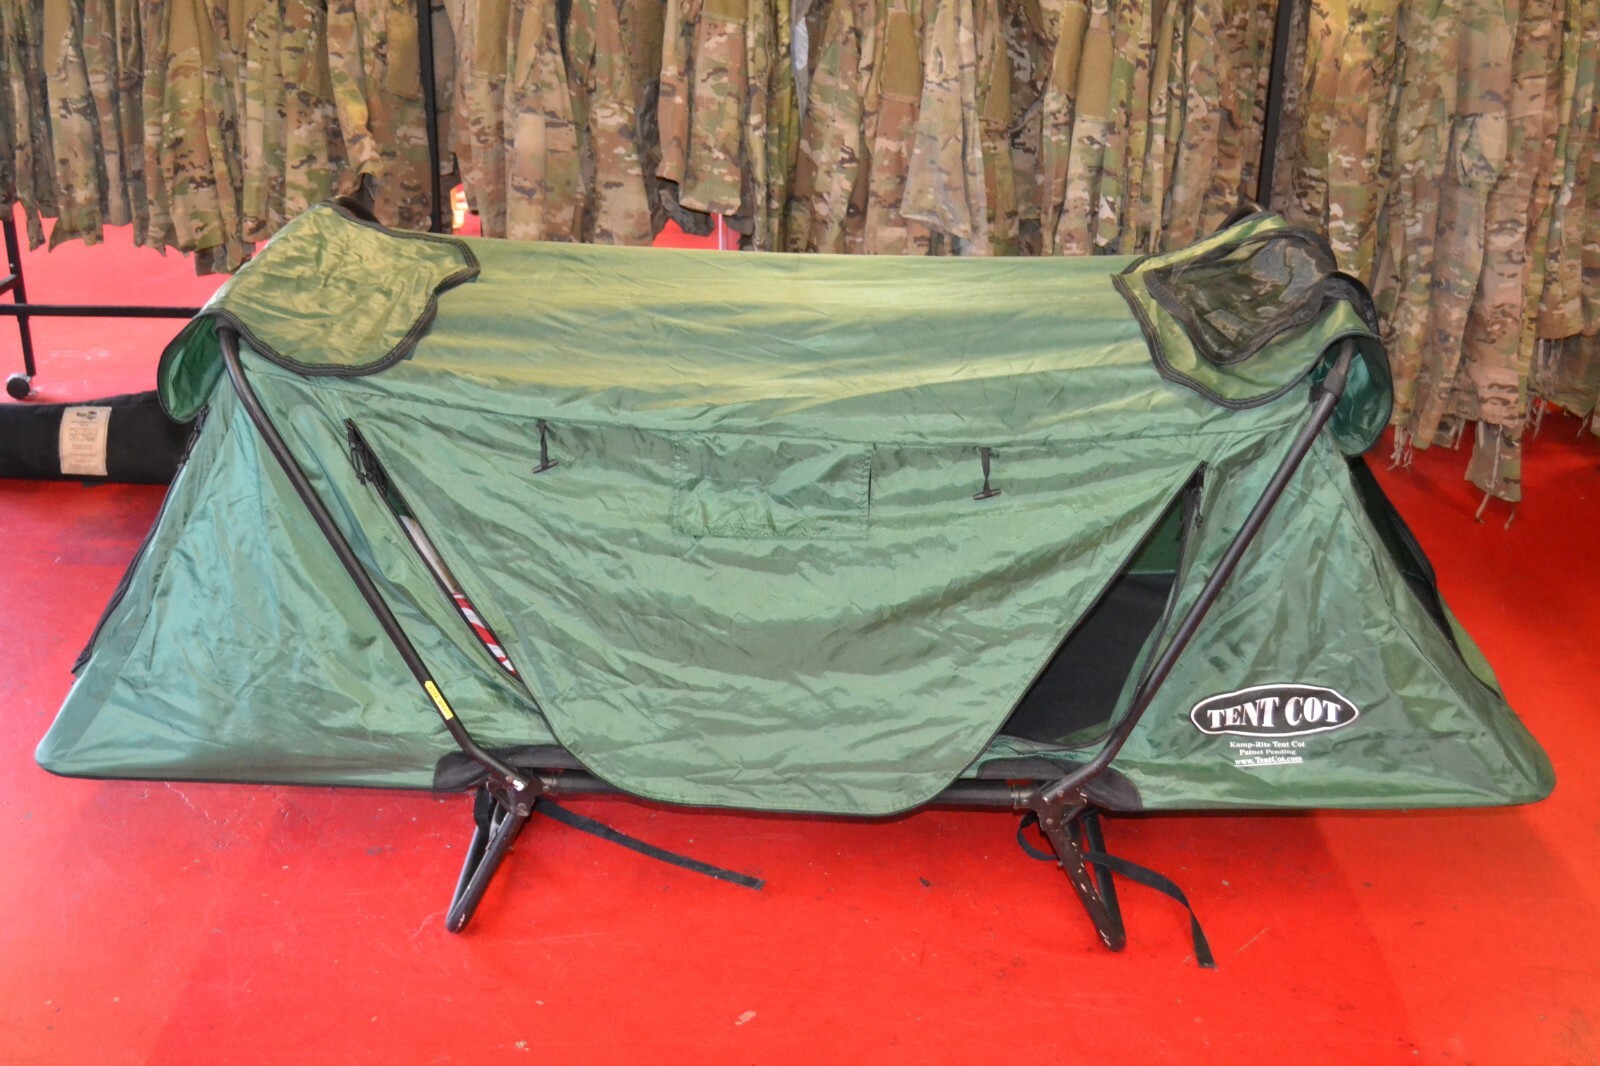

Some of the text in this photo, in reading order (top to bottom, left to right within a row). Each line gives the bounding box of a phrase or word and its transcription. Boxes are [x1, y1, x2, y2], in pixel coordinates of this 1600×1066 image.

[1207, 696, 1341, 728] TENT COT
[1229, 741, 1271, 749] Kamp-Rite
[1291, 740, 1305, 748] Cot
